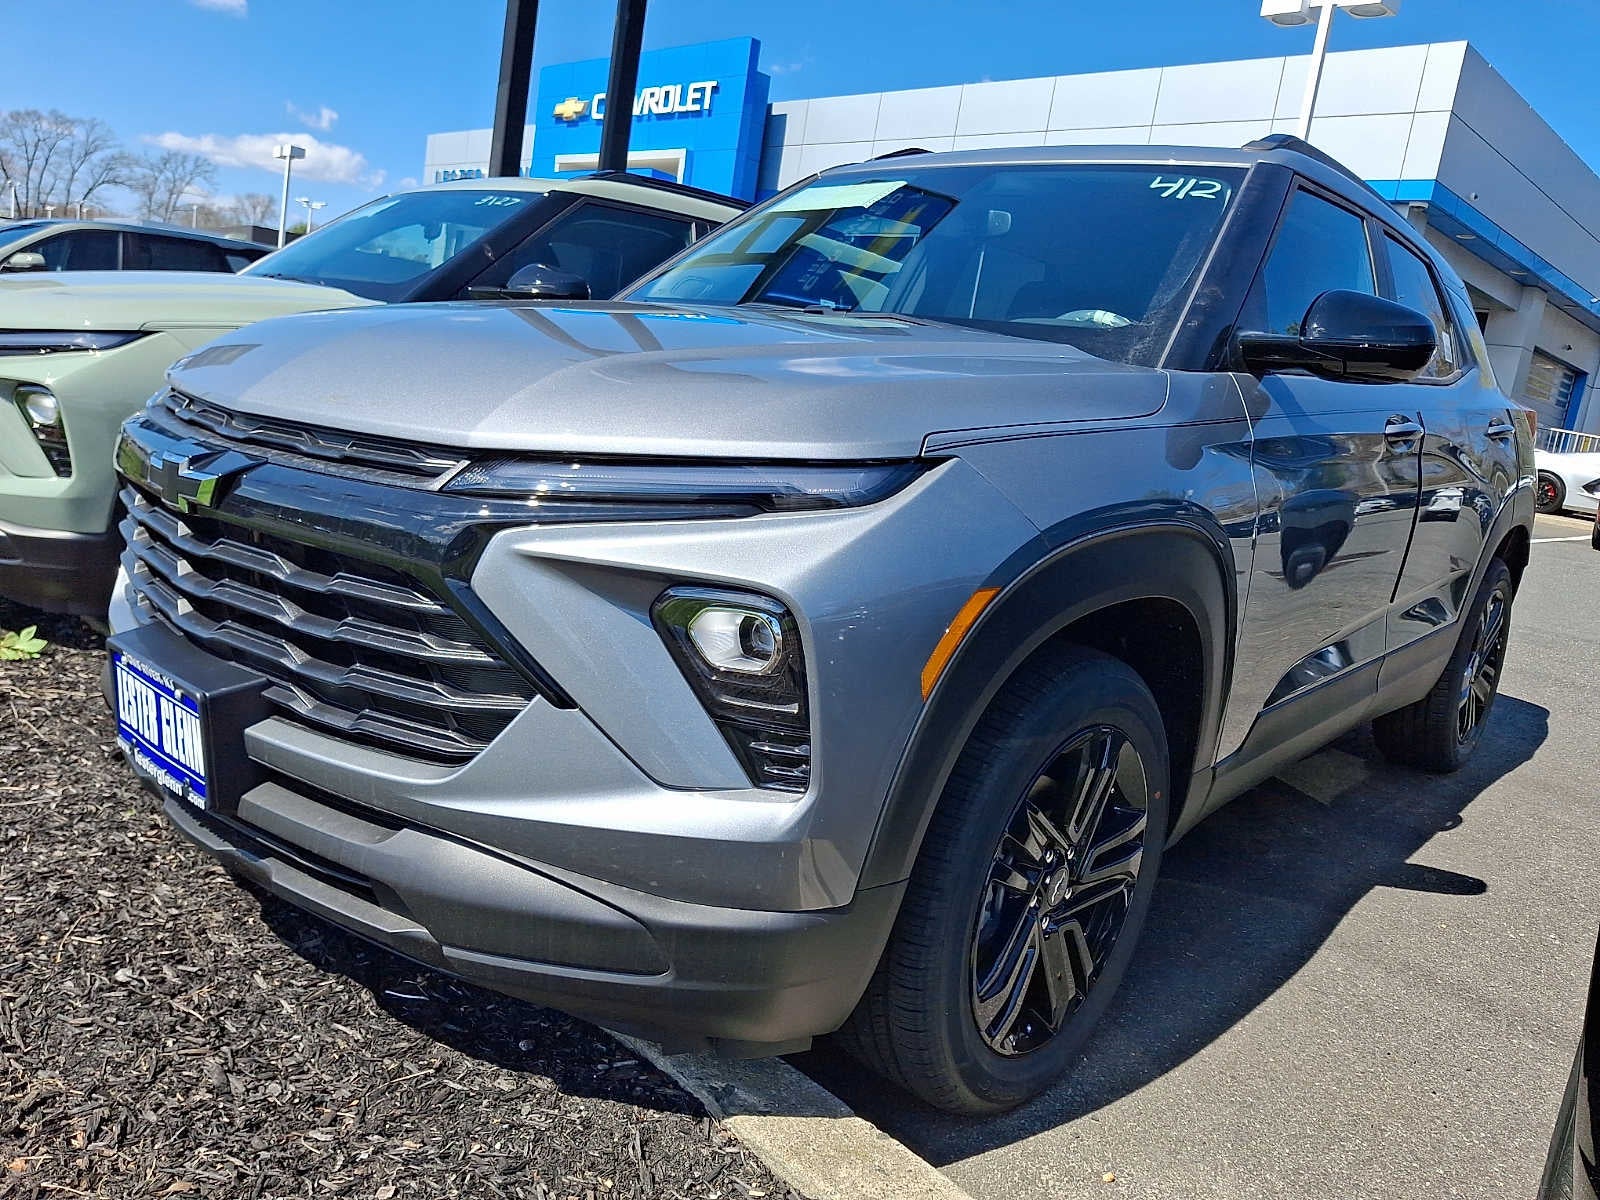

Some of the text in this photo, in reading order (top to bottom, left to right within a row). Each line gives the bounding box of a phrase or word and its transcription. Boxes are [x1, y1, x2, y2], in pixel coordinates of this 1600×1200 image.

[591, 81, 718, 120] CVROLET
[1150, 176, 1222, 199] 412
[117, 666, 205, 776] LESTER GLENN
